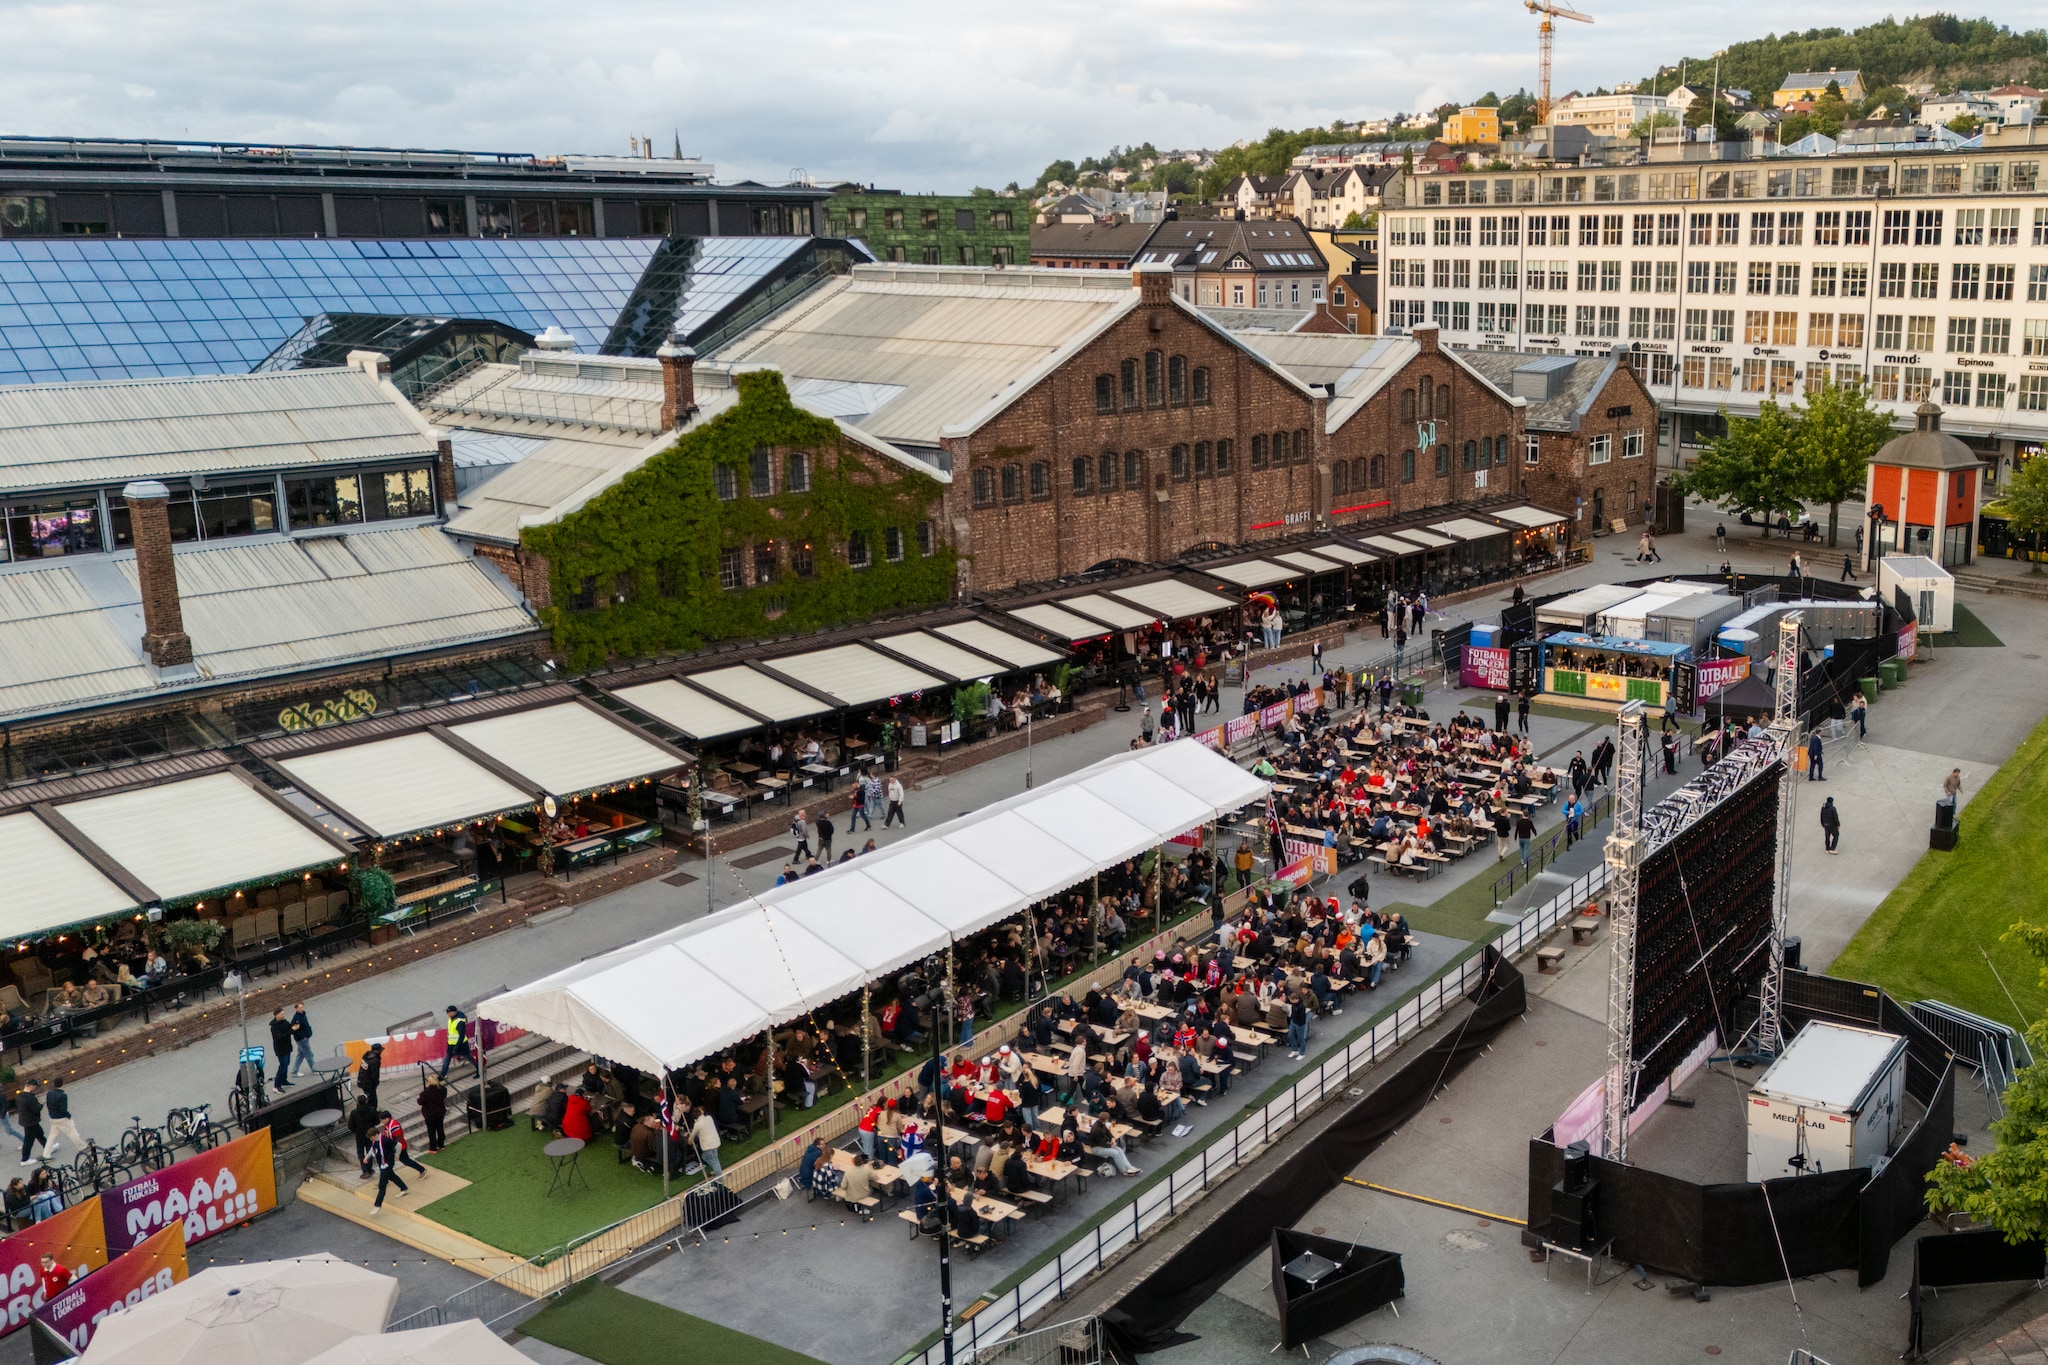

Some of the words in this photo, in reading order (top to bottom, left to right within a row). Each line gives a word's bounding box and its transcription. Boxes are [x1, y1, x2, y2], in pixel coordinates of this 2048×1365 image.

[1957, 357, 1994, 367] Epinova
[1285, 511, 1311, 526] GRAFFI
[1468, 648, 1505, 660] FOTBALL
[1698, 665, 1741, 683] OTBALL
[1285, 838, 1328, 861] OTBALL
[122, 1178, 158, 1196] FOTBALL
[126, 1167, 237, 1236] MÅÅÅ
[52, 1288, 85, 1312] FOTBALL
